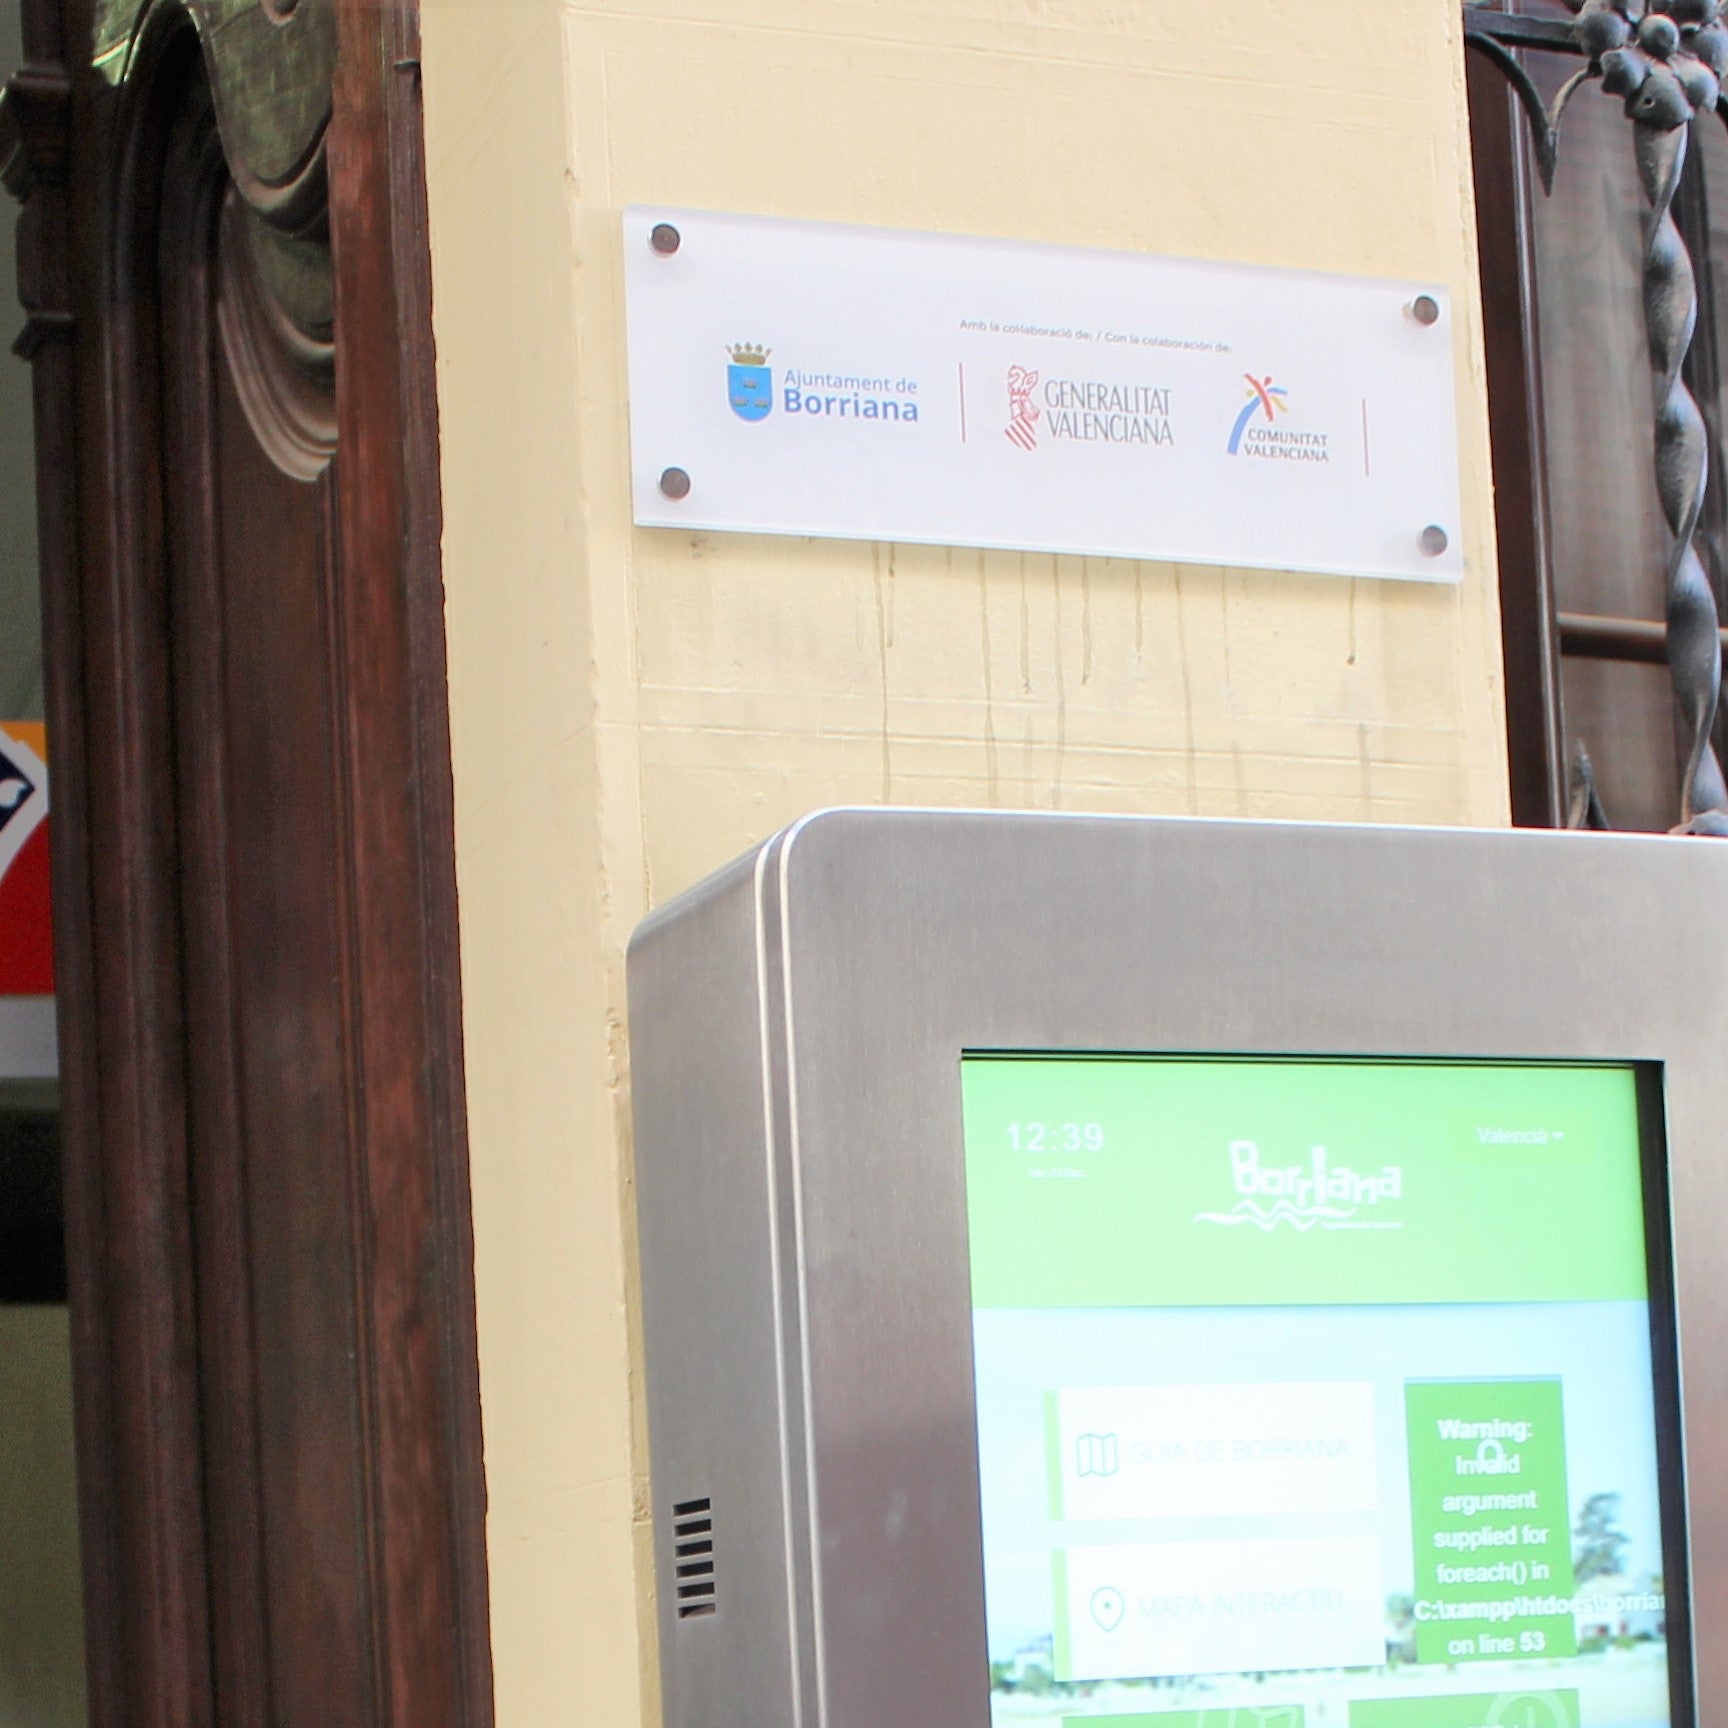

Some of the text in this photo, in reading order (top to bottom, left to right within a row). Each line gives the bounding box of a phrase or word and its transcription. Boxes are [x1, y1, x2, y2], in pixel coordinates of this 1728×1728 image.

[959, 318, 987, 332] Amb
[989, 320, 1001, 332] la
[1104, 331, 1128, 343] Con
[1129, 333, 1140, 345] la
[1142, 335, 1214, 352] colaboración
[784, 369, 918, 394] Ajuntament de
[783, 388, 919, 422] Borriana
[1044, 379, 1172, 416] GENERALITAT
[1045, 409, 1174, 446] VALENCIANA
[1247, 427, 1328, 448] COMUNITAT
[1244, 443, 1330, 463] VALENCIANA
[1007, 1121, 1104, 1152] 12:39
[1476, 1123, 1548, 1146] Valencià
[1229, 1139, 1402, 1206] Borriana
[1436, 1417, 1534, 1443] Warning:
[1128, 1436, 1352, 1464] GUIA DE BORRIANA
[1454, 1452, 1520, 1475] Invalid
[1441, 1489, 1538, 1516] argument
[1432, 1524, 1550, 1551] supplied for
[1435, 1560, 1550, 1586] foreach() in
[1447, 1630, 1547, 1656] on line 53
